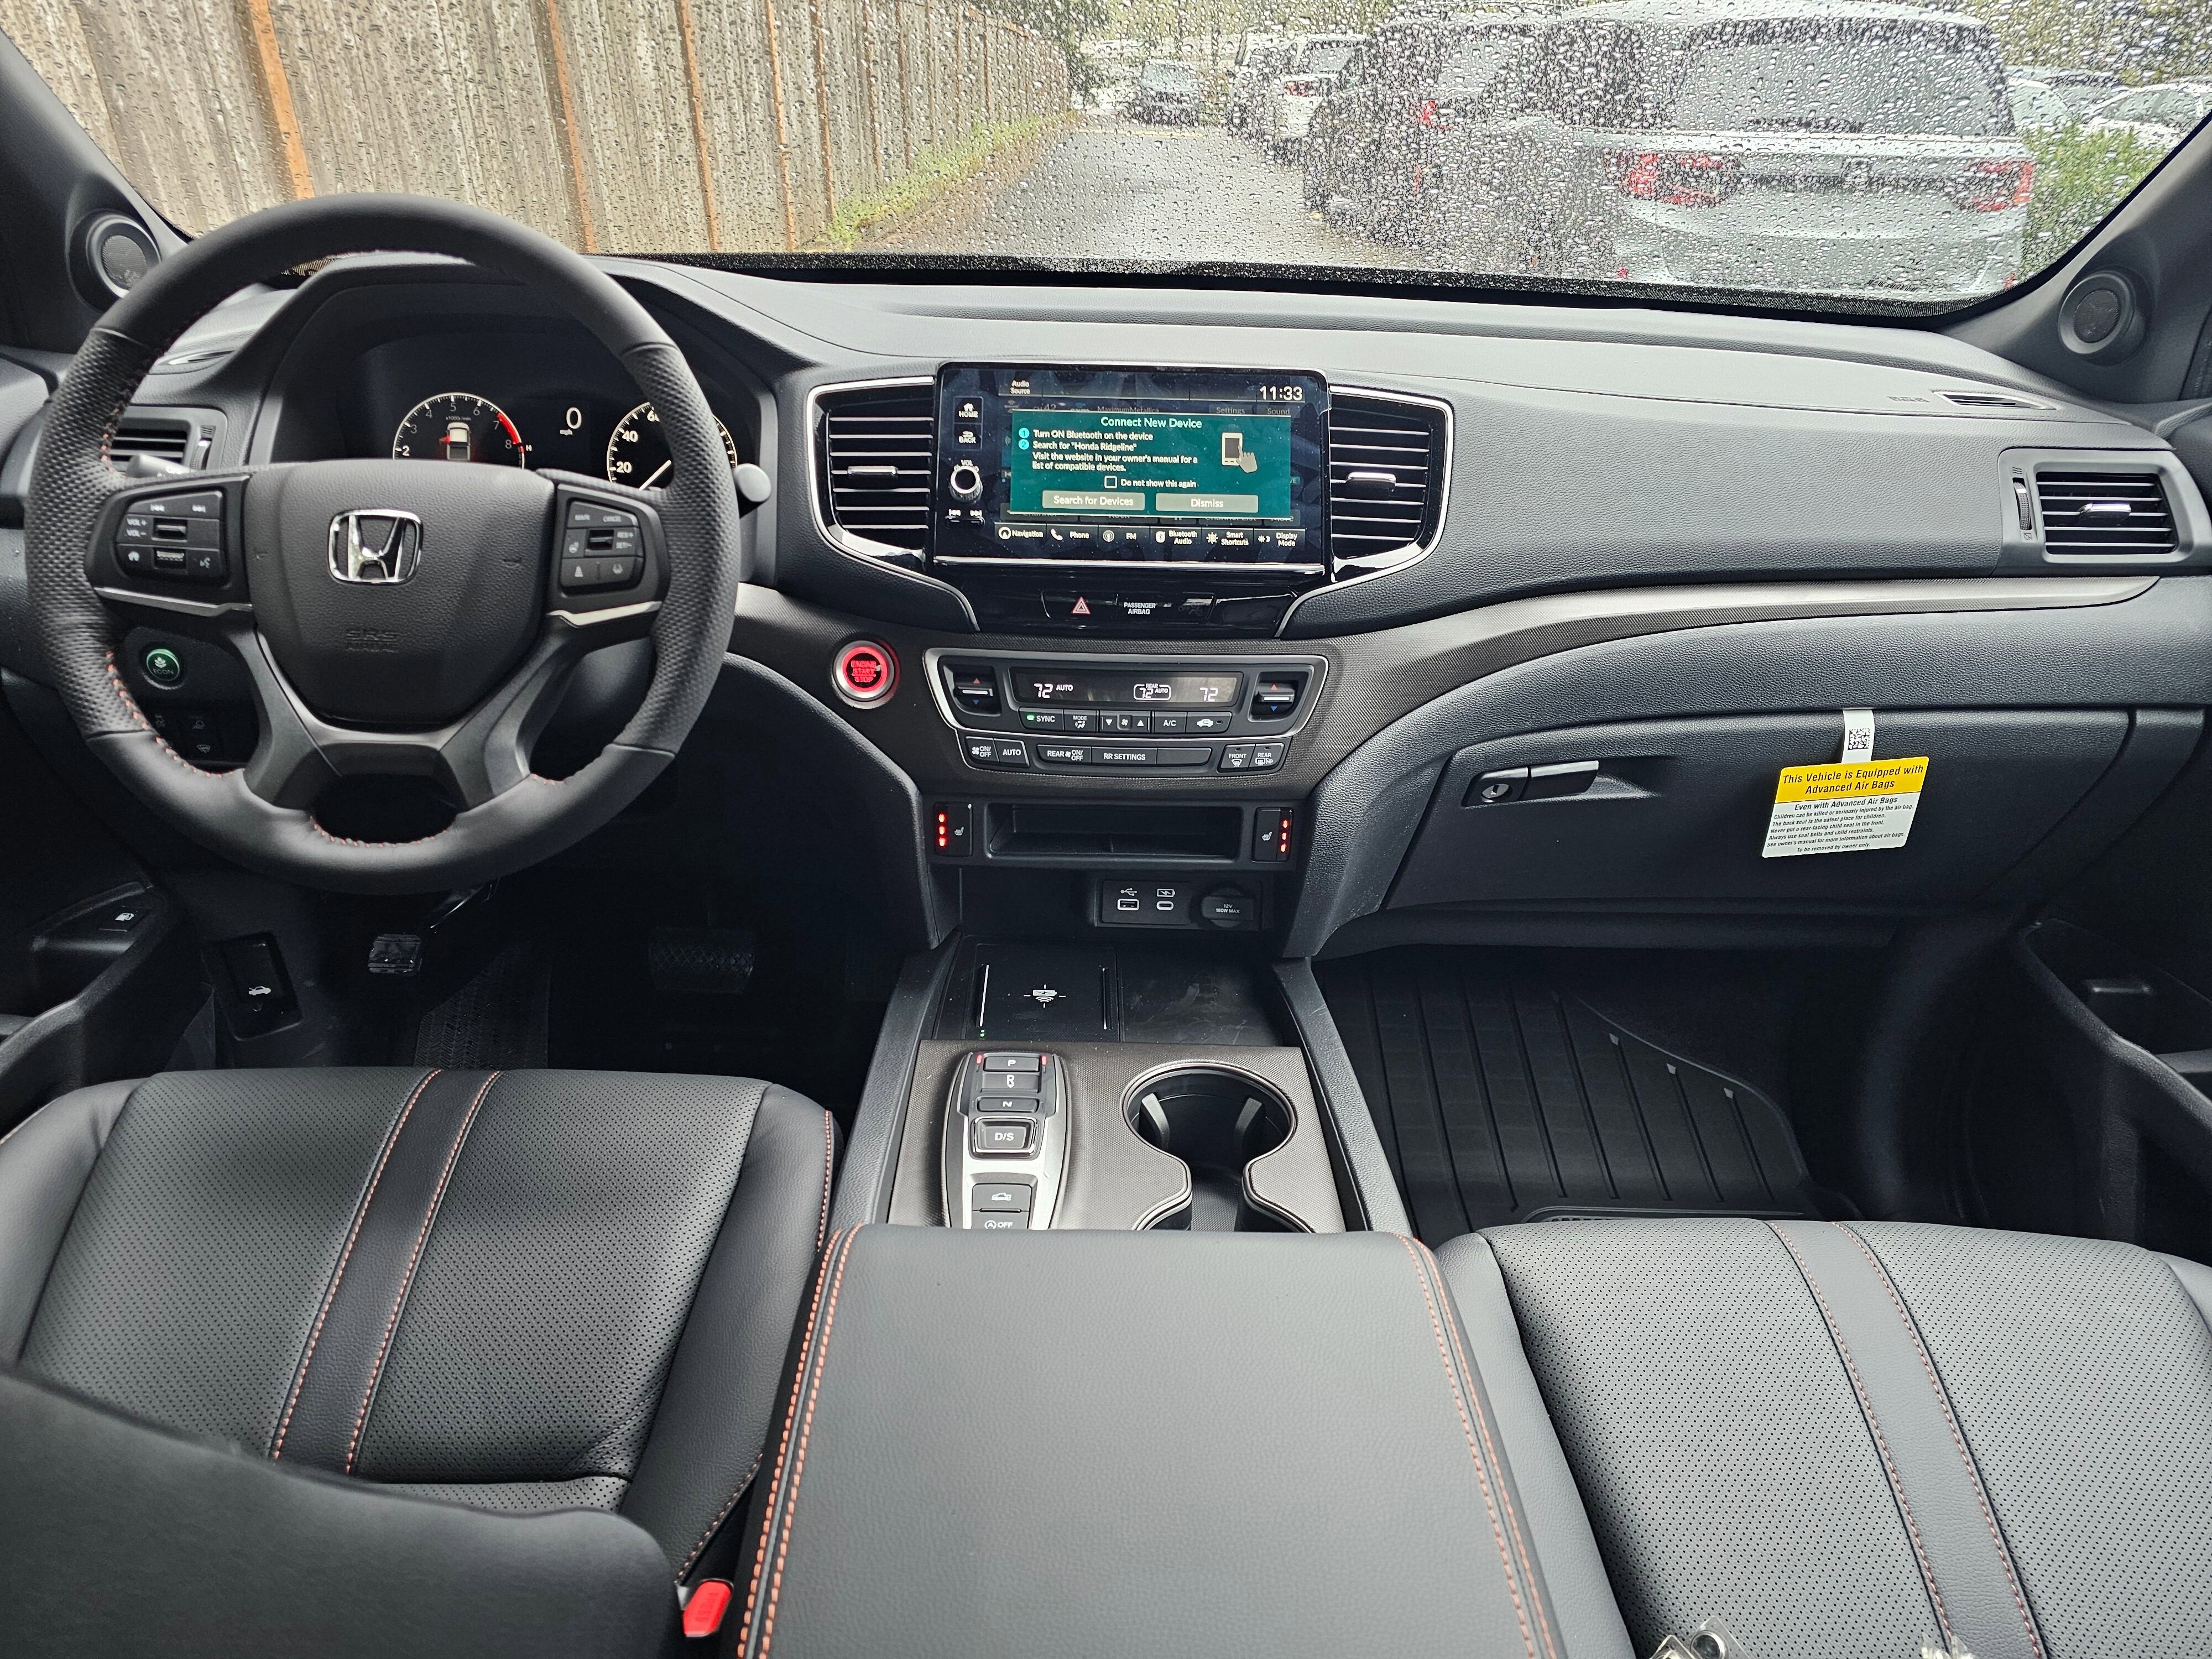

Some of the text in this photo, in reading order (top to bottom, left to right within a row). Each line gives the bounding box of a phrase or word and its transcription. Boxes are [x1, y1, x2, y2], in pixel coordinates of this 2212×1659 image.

[1260, 386, 1303, 401] 11:33
[450, 403, 456, 411] 5
[473, 406, 480, 416] 6
[566, 407, 582, 429] 0
[1100, 417, 1202, 428] Connect New Device
[410, 425, 417, 434] 3
[493, 421, 499, 430] 7
[622, 430, 638, 442] 40
[1033, 429, 1050, 438] Turn
[1066, 430, 1103, 439] Bluetooth
[1115, 431, 1128, 440] the
[1129, 432, 1154, 440] device
[505, 440, 512, 448] 8
[1033, 440, 1057, 449] Search
[1071, 441, 1099, 450] "Honda
[1100, 442, 1137, 452] Ridgeline"
[403, 445, 410, 456] 2
[1032, 451, 1050, 460] Visit
[1065, 453, 1094, 461] website
[1104, 455, 1121, 463] your
[1121, 455, 1151, 463] owner's
[1152, 455, 1179, 463] manual
[1180, 455, 1192, 463] for
[616, 461, 632, 473] 20
[1055, 462, 1095, 471] compatible
[1097, 463, 1126, 471] devices.
[1053, 495, 1134, 506] Search for Devices
[1191, 499, 1223, 508] Dismiss
[1012, 530, 1043, 539] Navigation
[1276, 532, 1297, 541] Display
[1034, 684, 1053, 698] 72
[1140, 688, 1154, 698] 72
[1200, 688, 1218, 701] 72
[1783, 765, 1923, 784] This Vehicle is Equipped with
[1805, 781, 1895, 794] Advanced Air Bags
[1831, 799, 1866, 807] Advanced
[995, 1133, 1014, 1141] D/S
